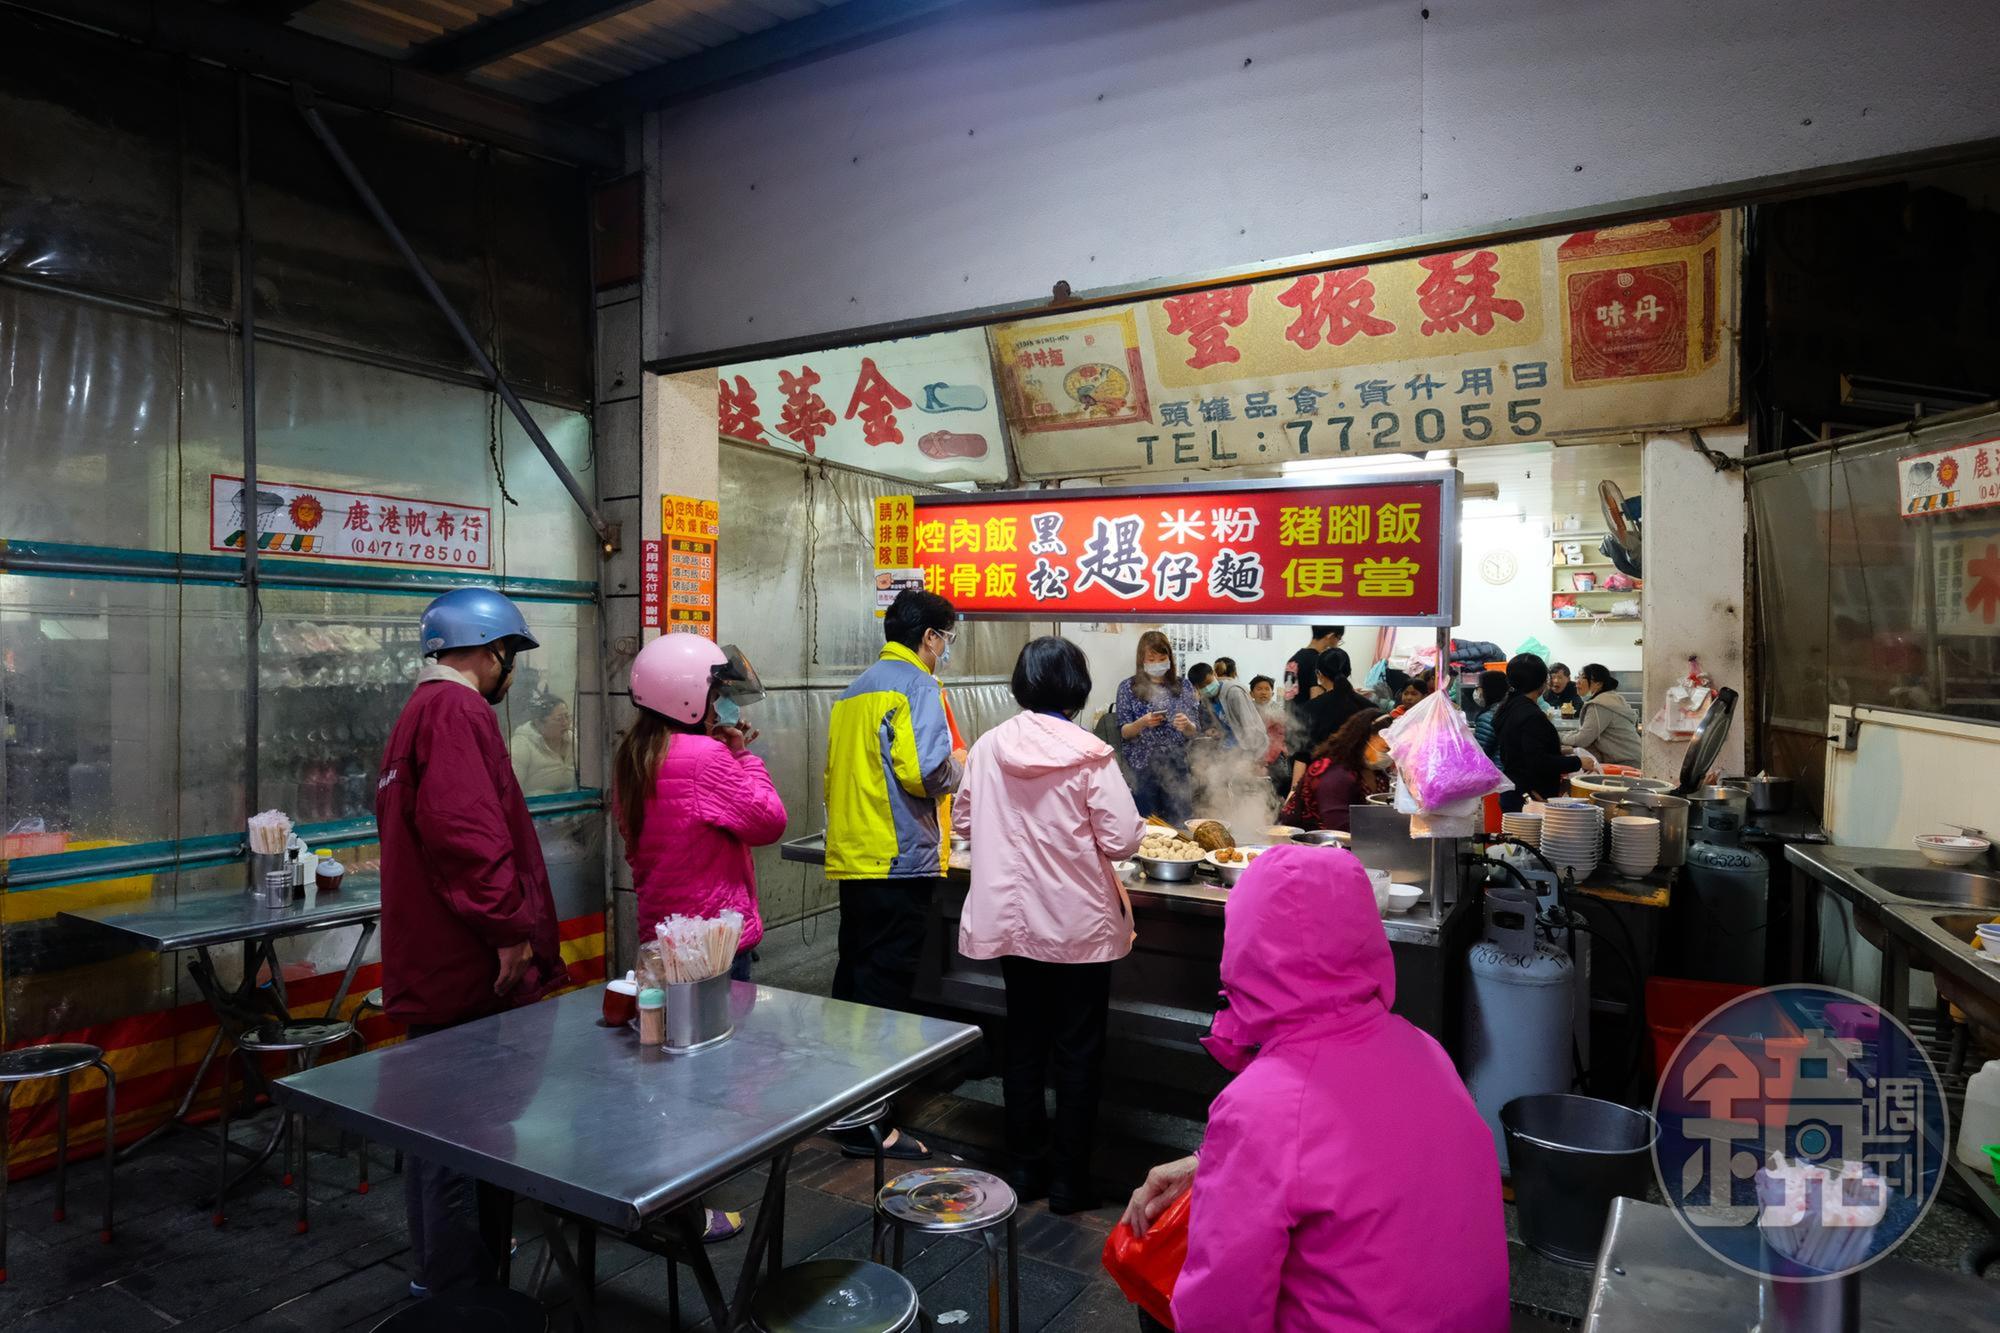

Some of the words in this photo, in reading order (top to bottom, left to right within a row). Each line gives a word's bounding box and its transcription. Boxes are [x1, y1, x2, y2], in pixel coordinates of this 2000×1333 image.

[1596, 294, 1664, 328] 味丹
[342, 500, 483, 543] 鹿港帆布行
[879, 502, 892, 565] 請排隊
[896, 502, 909, 565] 外帶區
[1157, 507, 1260, 544] 米粉
[1279, 503, 1422, 547] 豬腳飯
[351, 538, 477, 563] (04)7778500
[1028, 512, 1068, 601] 黑松
[1280, 556, 1420, 598] 便當
